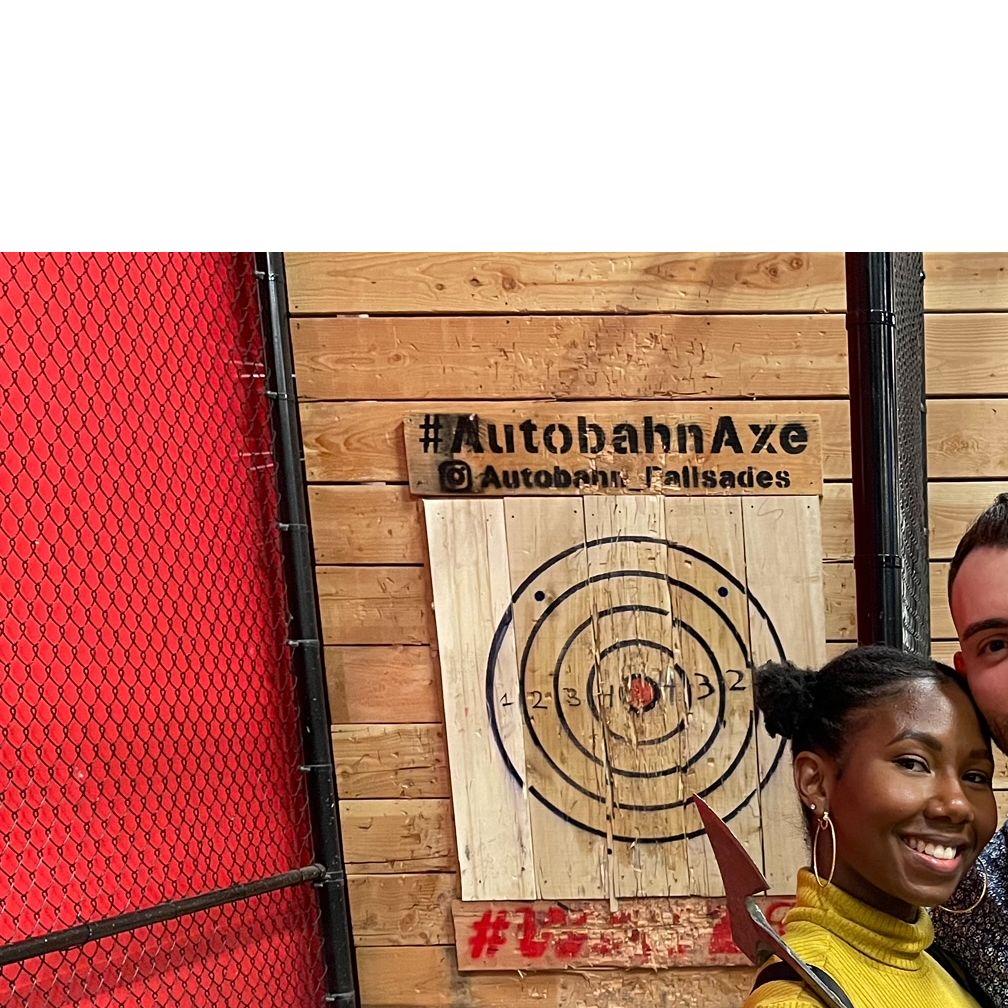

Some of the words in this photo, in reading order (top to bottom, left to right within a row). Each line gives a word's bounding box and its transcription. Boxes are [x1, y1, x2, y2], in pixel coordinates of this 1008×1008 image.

[419, 413, 809, 454] #AutobahnAxe
[531, 690, 548, 709] 2
[694, 672, 715, 700] 3
[726, 669, 746, 691] 2
